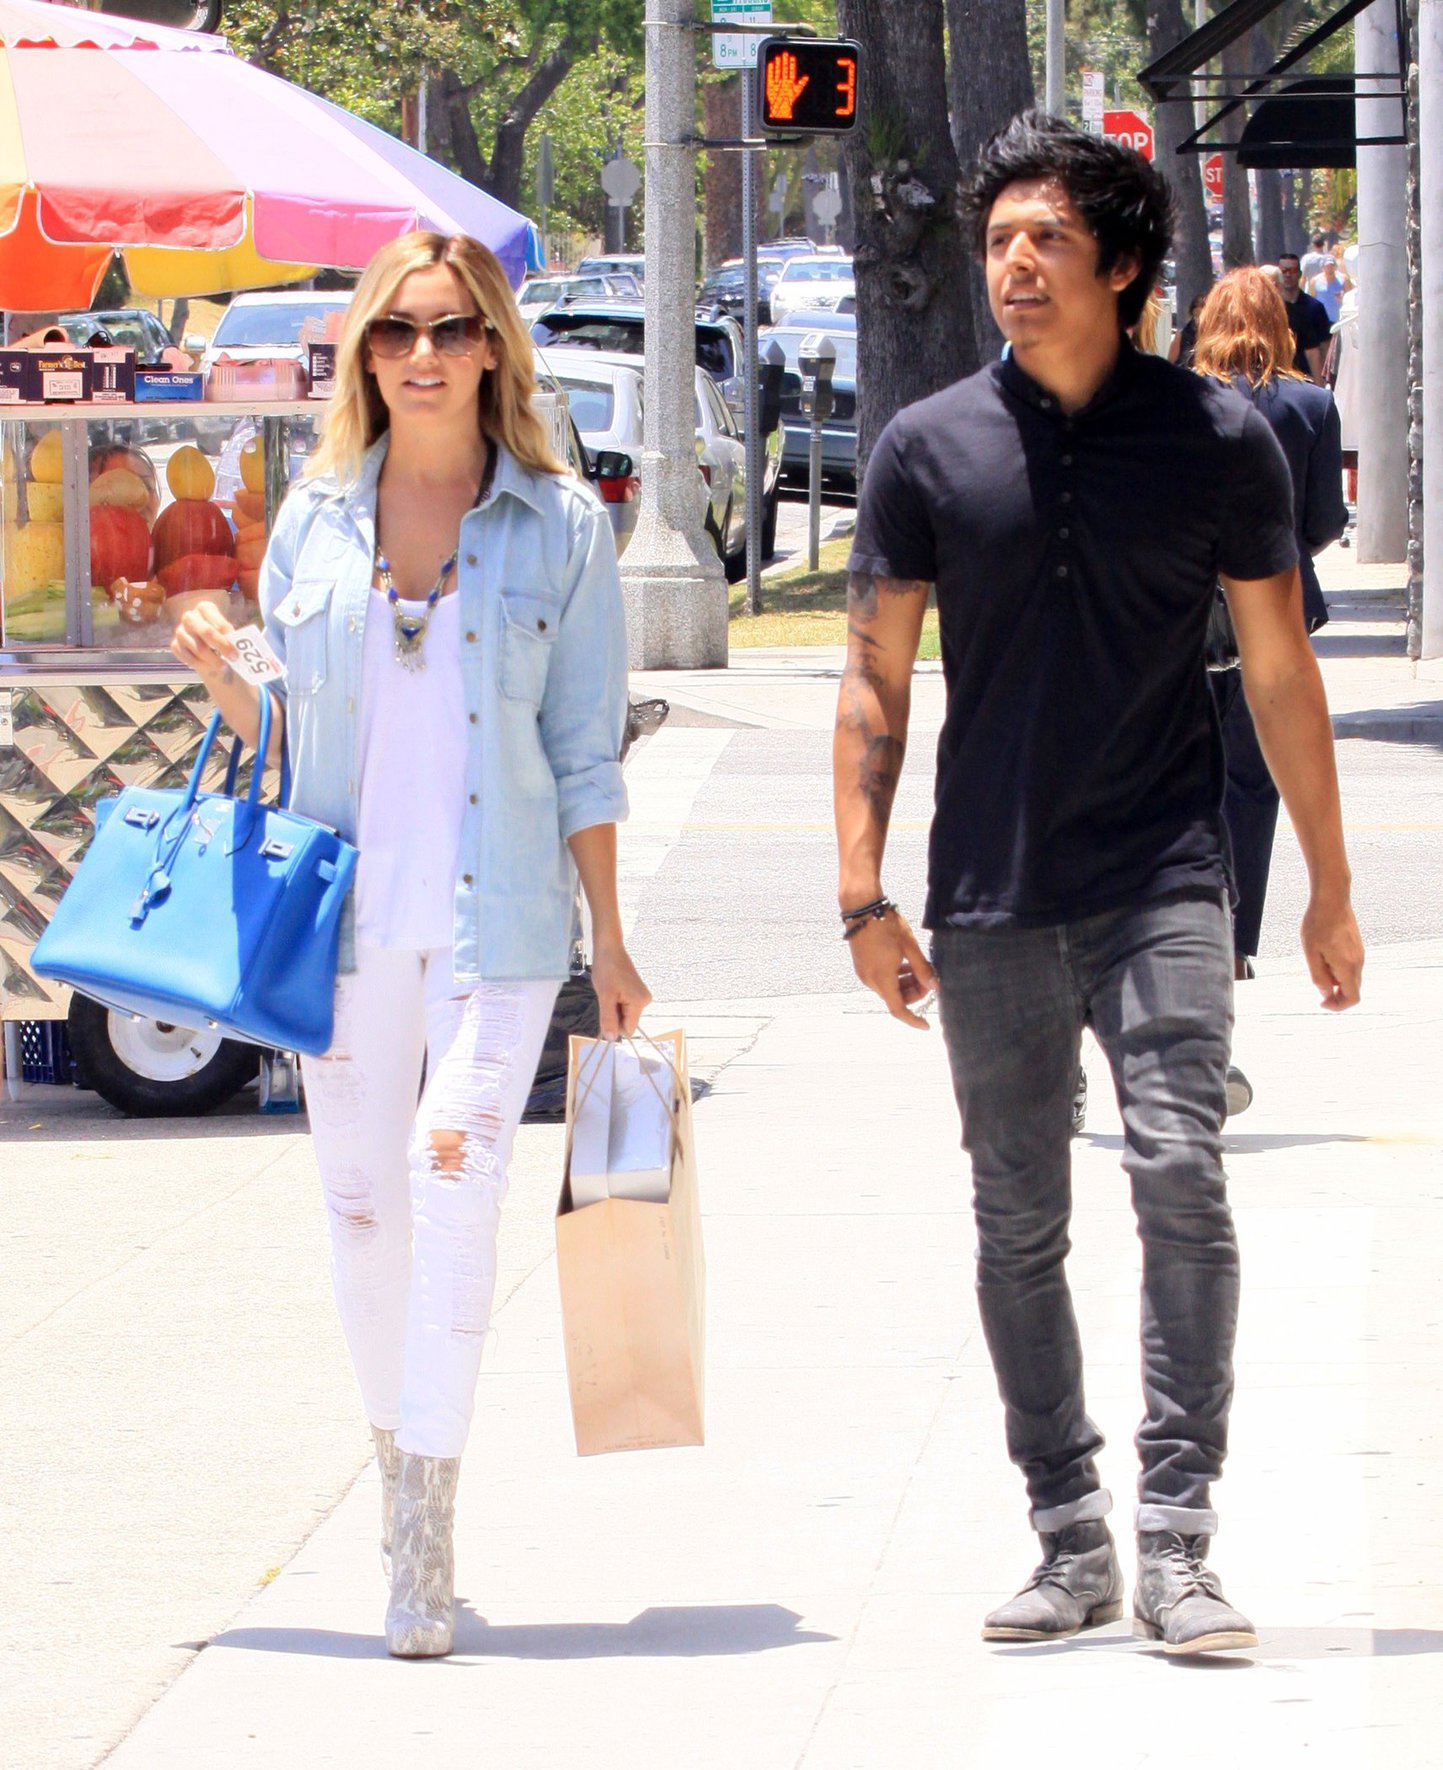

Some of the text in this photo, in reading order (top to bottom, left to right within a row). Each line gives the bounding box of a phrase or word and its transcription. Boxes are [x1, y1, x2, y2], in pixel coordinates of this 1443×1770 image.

[835, 58, 855, 115] 3
[1103, 132, 1149, 152] TOP
[1206, 167, 1222, 183] ST
[144, 375, 194, 384] Clean Ones
[235, 638, 270, 674] 529
